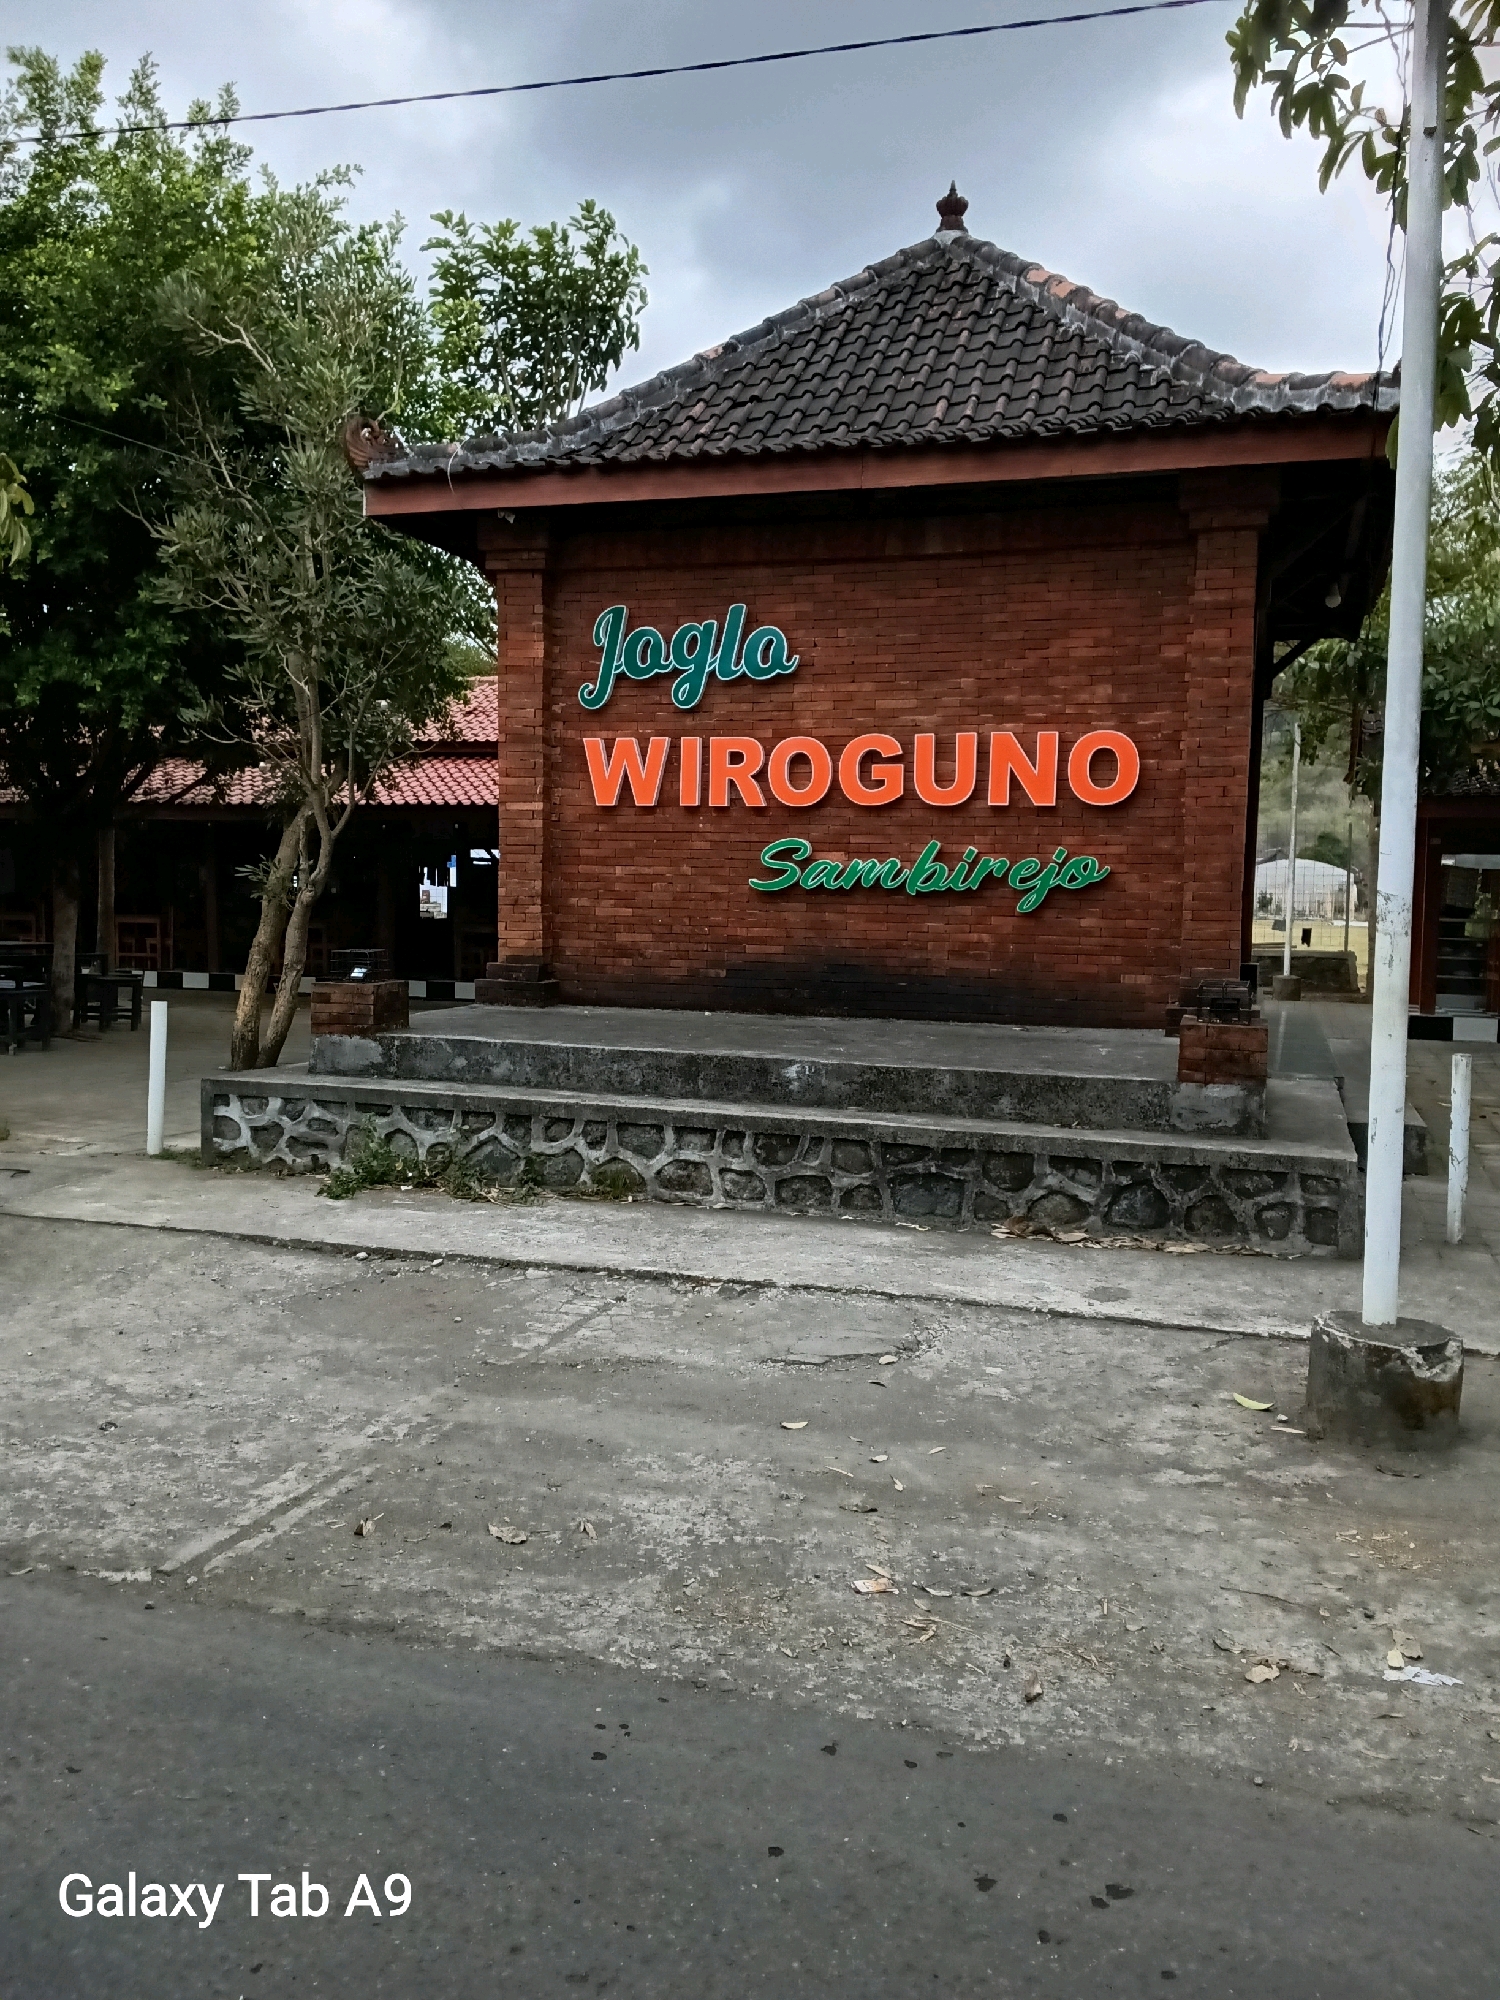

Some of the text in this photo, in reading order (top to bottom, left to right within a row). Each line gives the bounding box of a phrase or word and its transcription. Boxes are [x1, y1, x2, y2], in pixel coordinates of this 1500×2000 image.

[578, 603, 799, 709] Joglo
[583, 729, 1140, 807] WIROGUNO
[748, 837, 1110, 913] Sambirejo
